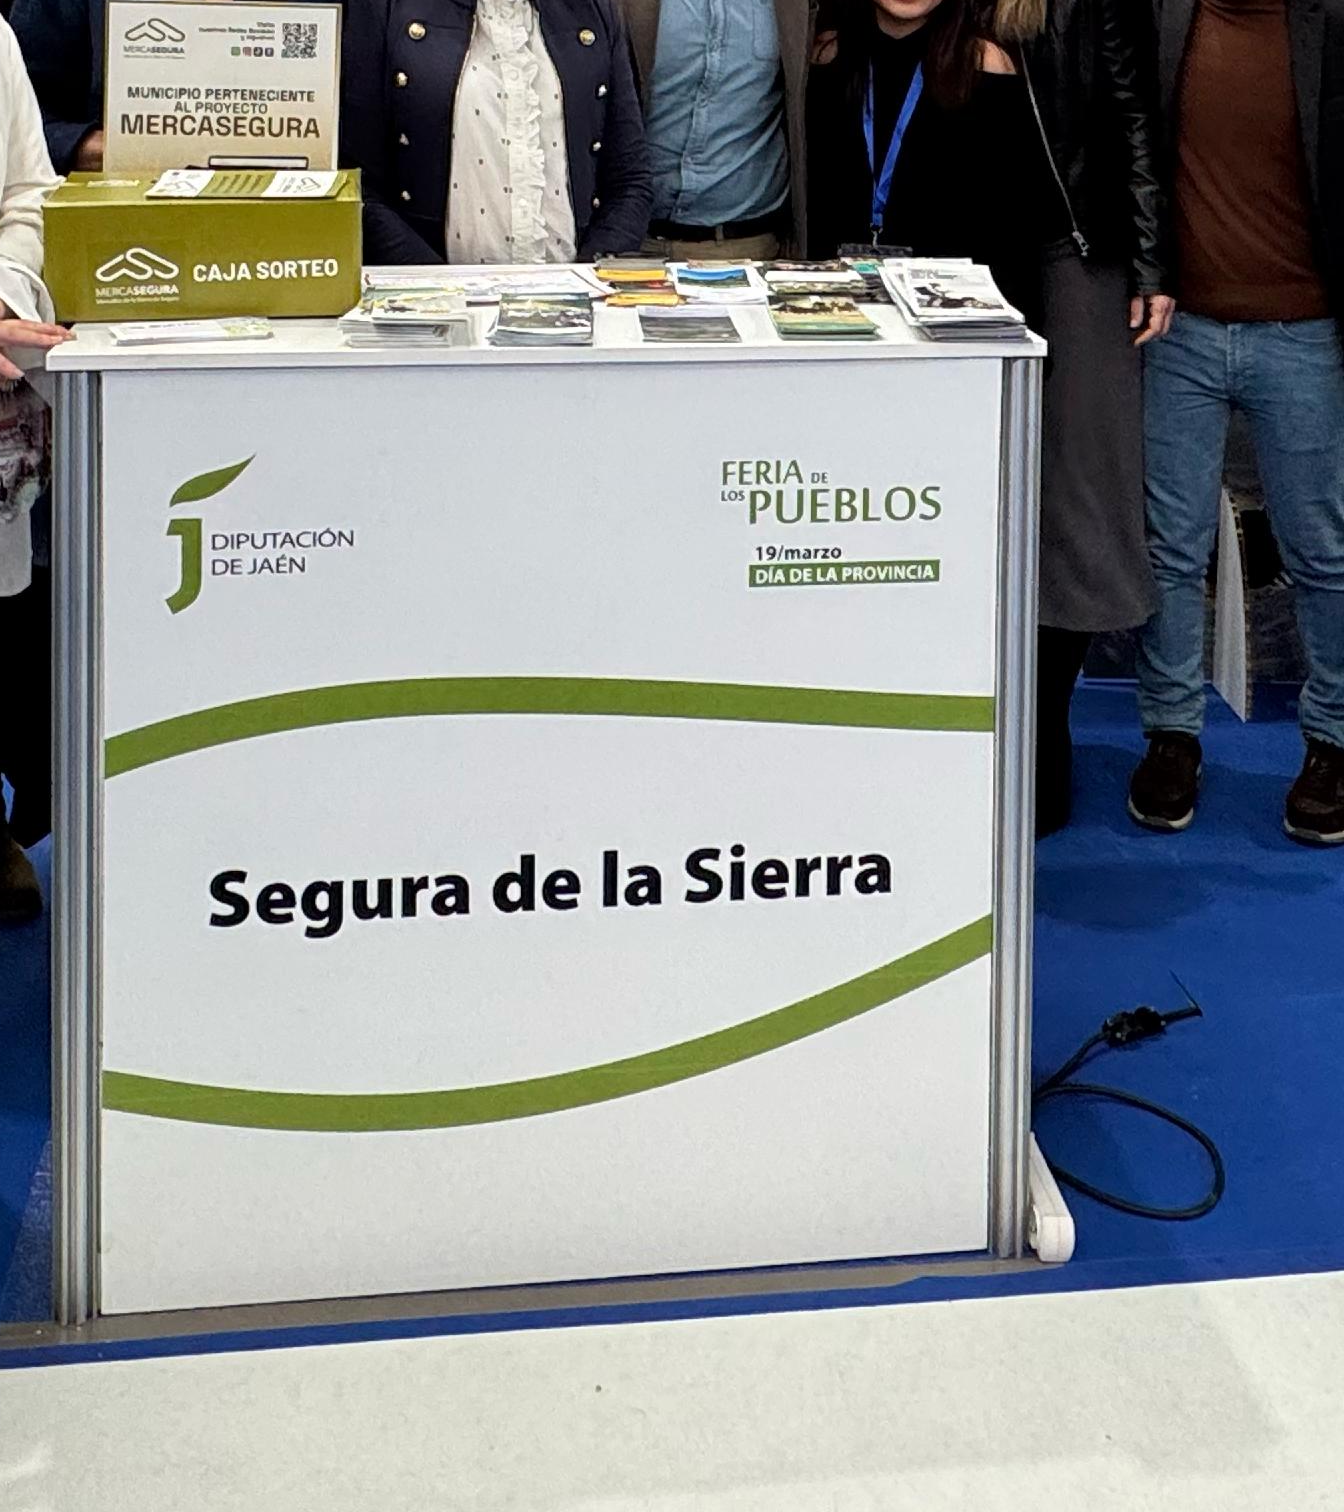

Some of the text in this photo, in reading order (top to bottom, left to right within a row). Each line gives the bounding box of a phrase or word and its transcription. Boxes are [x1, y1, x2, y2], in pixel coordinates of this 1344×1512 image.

[127, 87, 315, 103] MUNICIPIO PERTENECIENTE
[174, 102, 268, 115] AL PROYECTO
[120, 114, 321, 139] MERCASEGURA
[193, 258, 339, 283] CAJA SORTEO
[95, 284, 180, 298] MERCASEGURA
[721, 459, 829, 486] FERIA DE
[720, 486, 942, 525] LOS PUEBLOS
[211, 527, 355, 551] DIPUTACIÓN
[211, 554, 306, 576] DE JAÉN
[755, 545, 842, 562] 19/marzo
[756, 564, 935, 585] DÍA DE LA PROVINCIA
[208, 843, 893, 939] Segura de la Sierra
